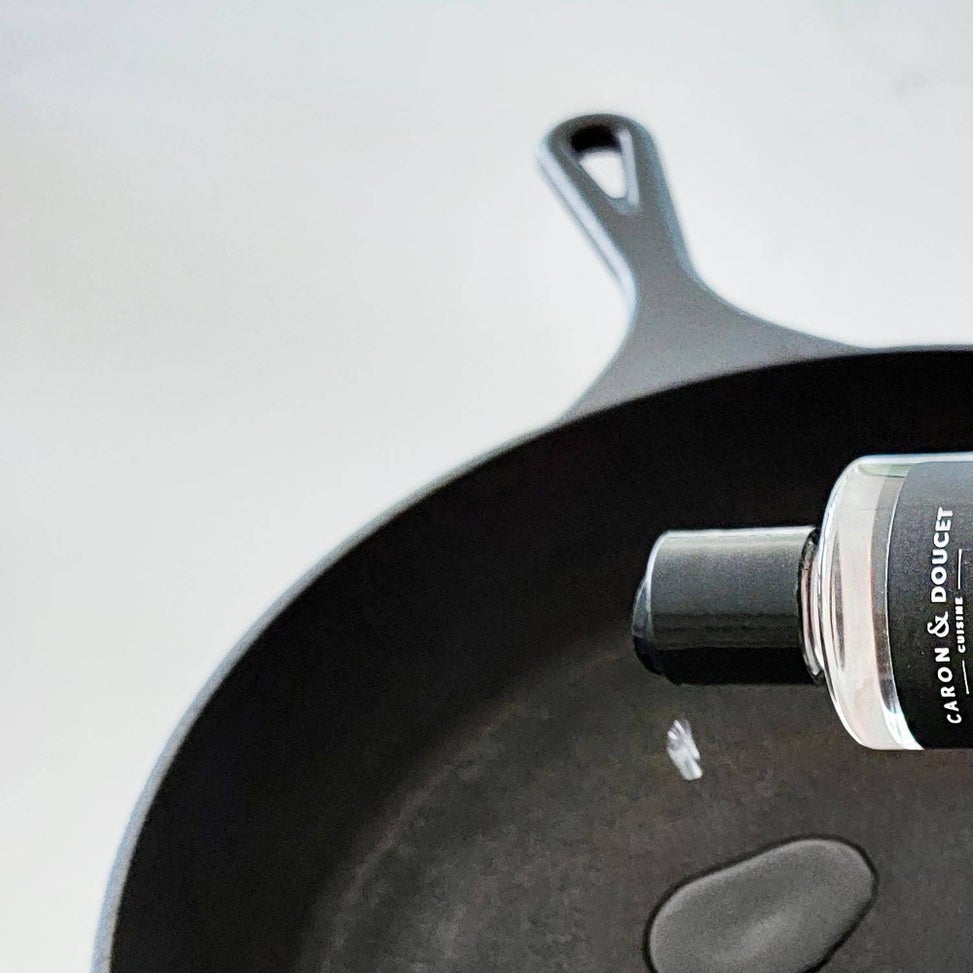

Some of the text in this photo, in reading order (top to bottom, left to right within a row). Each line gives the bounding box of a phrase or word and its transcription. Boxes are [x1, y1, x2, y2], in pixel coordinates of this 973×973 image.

[926, 505, 962, 724] CARON & DOUCET
[955, 597, 966, 653] CUISINE
